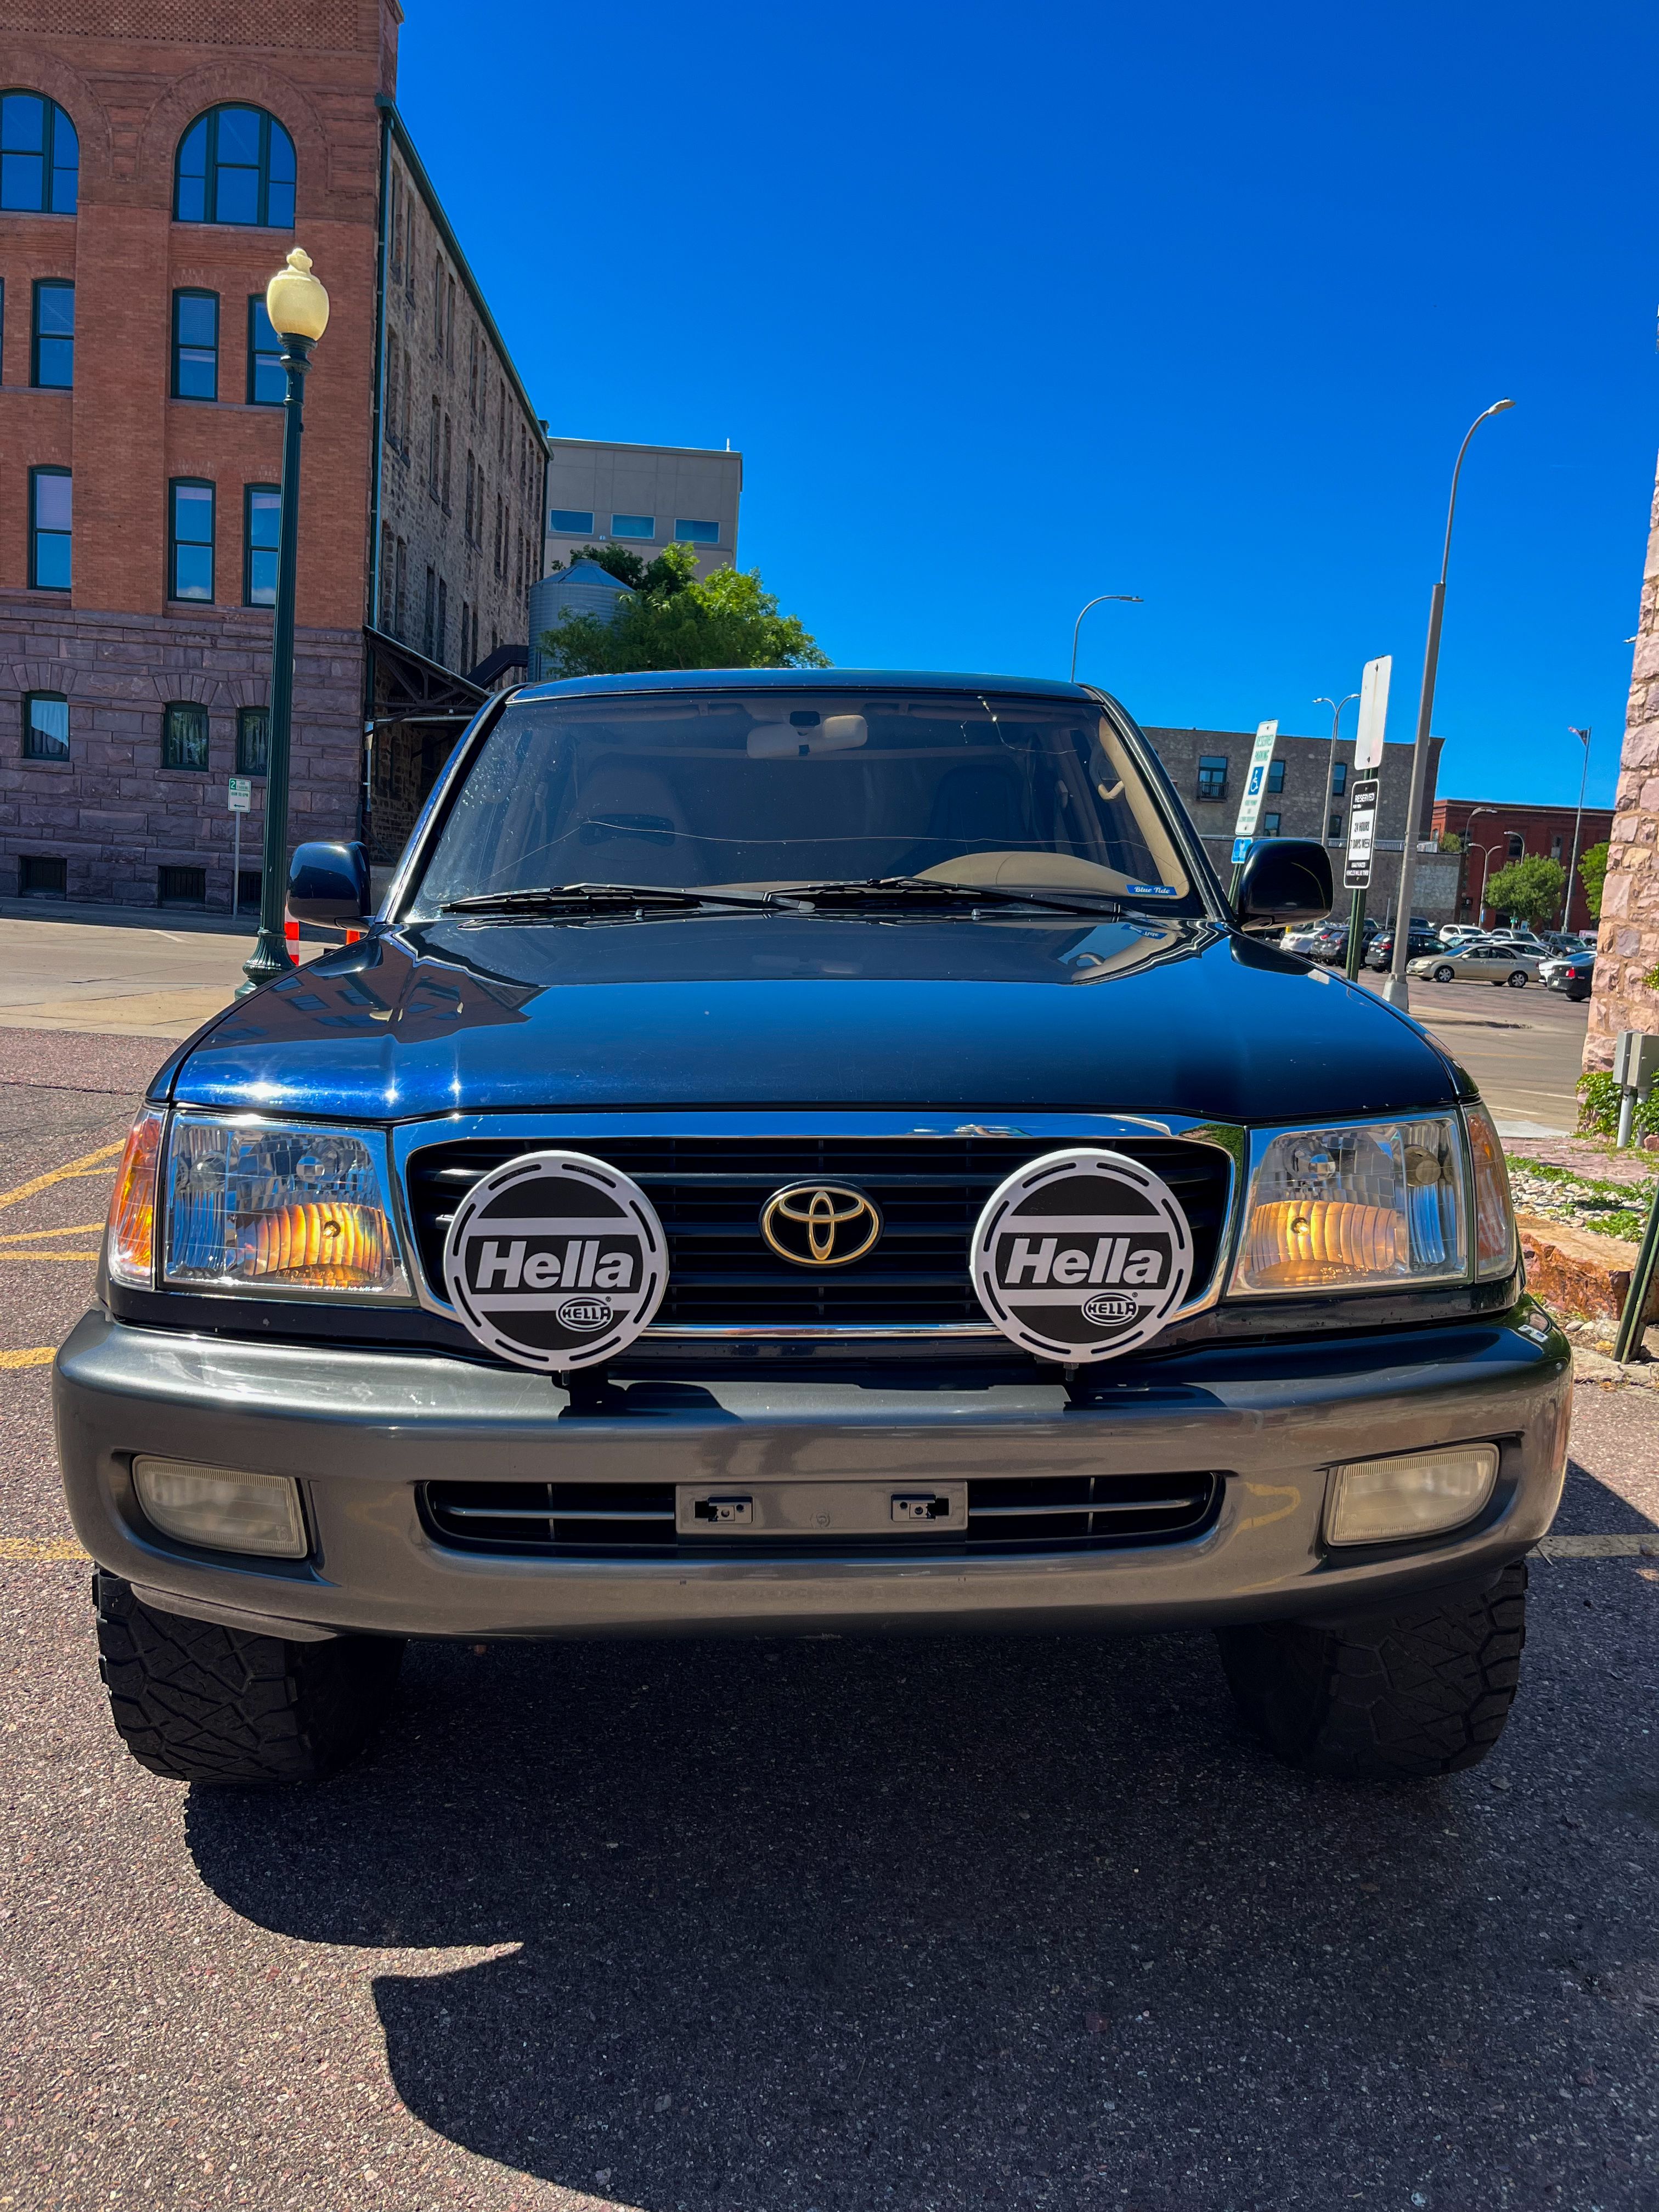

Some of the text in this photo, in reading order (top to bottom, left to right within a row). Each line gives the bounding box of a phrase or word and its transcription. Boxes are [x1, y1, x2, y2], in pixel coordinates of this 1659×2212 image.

[230, 780, 235, 789] 2
[1355, 793, 1375, 803] RESERVED
[475, 1240, 634, 1289] Hella
[1005, 1238, 1163, 1284] Hella
[562, 1305, 610, 1321] HELLA
[1088, 1301, 1136, 1316] HELLA
